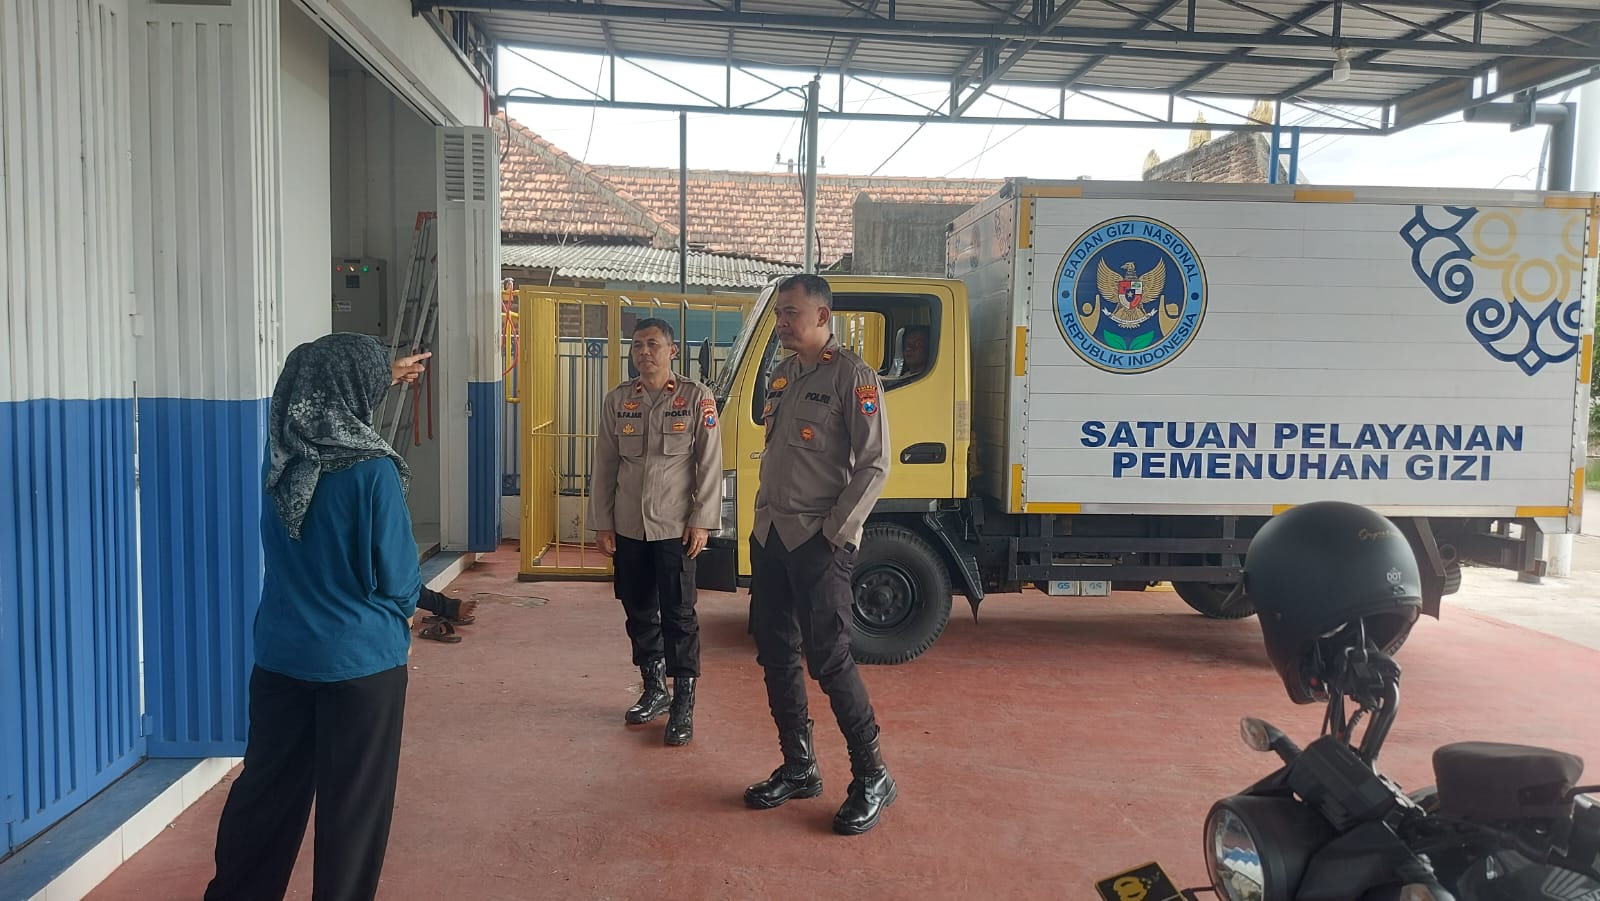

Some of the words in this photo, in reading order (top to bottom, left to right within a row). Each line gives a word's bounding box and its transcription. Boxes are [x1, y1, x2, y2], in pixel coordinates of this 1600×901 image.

[1064, 232, 1104, 280] BADAN
[1106, 223, 1135, 238] GIZI
[1143, 224, 1200, 283] NASIONAL
[1063, 312, 1124, 366] REPUBLIK
[1128, 313, 1198, 366] INDONESIA
[804, 391, 832, 404] POLRI
[664, 409, 691, 418] POLRI
[1079, 420, 1257, 449] SATUAN
[1273, 422, 1524, 452] PELAYANAN
[1112, 451, 1389, 481] PEMENUHAN
[1404, 453, 1491, 482] GIZI
[1057, 582, 1071, 590] GS
[1386, 571, 1402, 581] DOT
